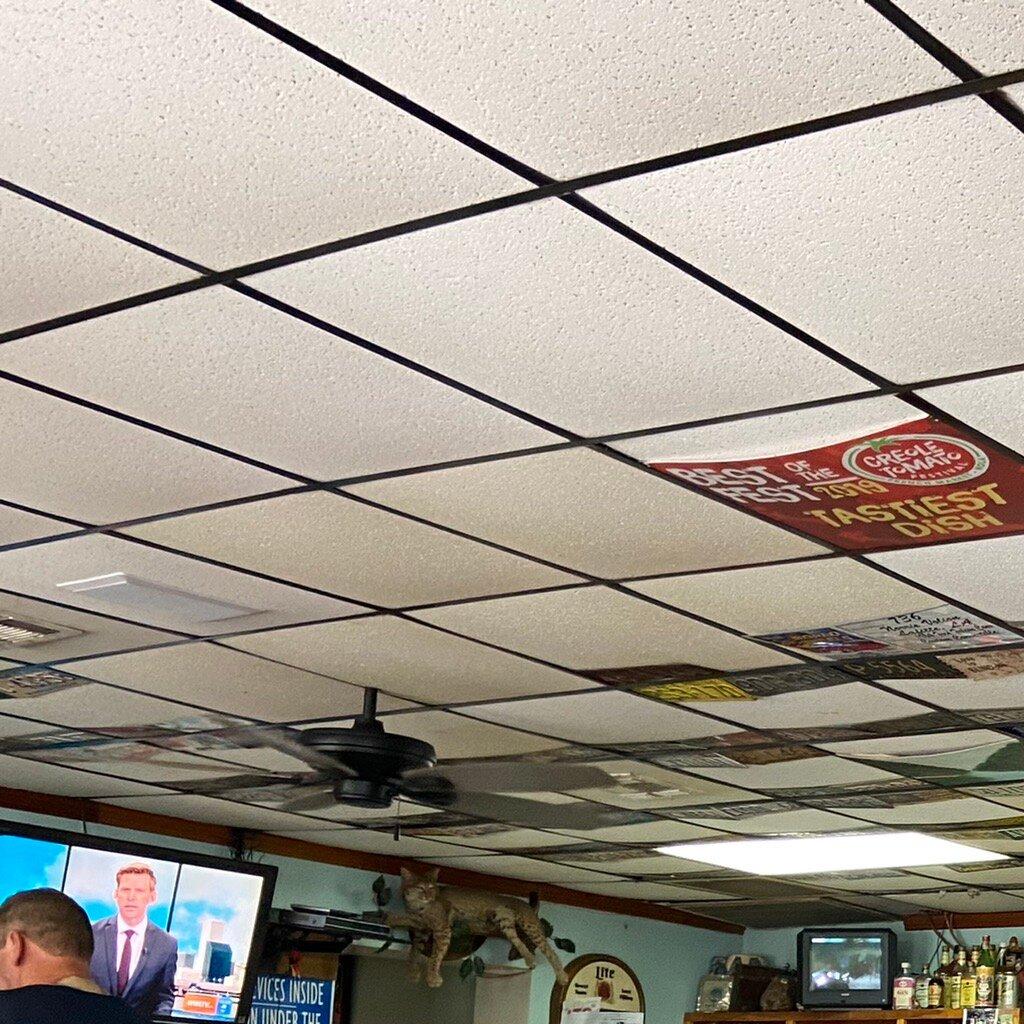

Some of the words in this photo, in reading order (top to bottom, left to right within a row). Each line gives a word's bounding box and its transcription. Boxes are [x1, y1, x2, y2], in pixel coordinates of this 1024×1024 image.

[863, 441, 938, 468] CREOLE
[879, 449, 961, 478] TOMATO
[666, 466, 788, 487] BEST
[784, 460, 814, 475] OF
[911, 462, 969, 479] FESTIVAL
[709, 483, 820, 504] FEST
[800, 467, 840, 482] THE
[813, 479, 890, 499] 2019
[803, 483, 1006, 528] TASTIEST
[892, 511, 1004, 538] DISH
[596, 966, 615, 980] Lite
[255, 977, 285, 1002] VICES
[290, 981, 324, 1005] INSIDE
